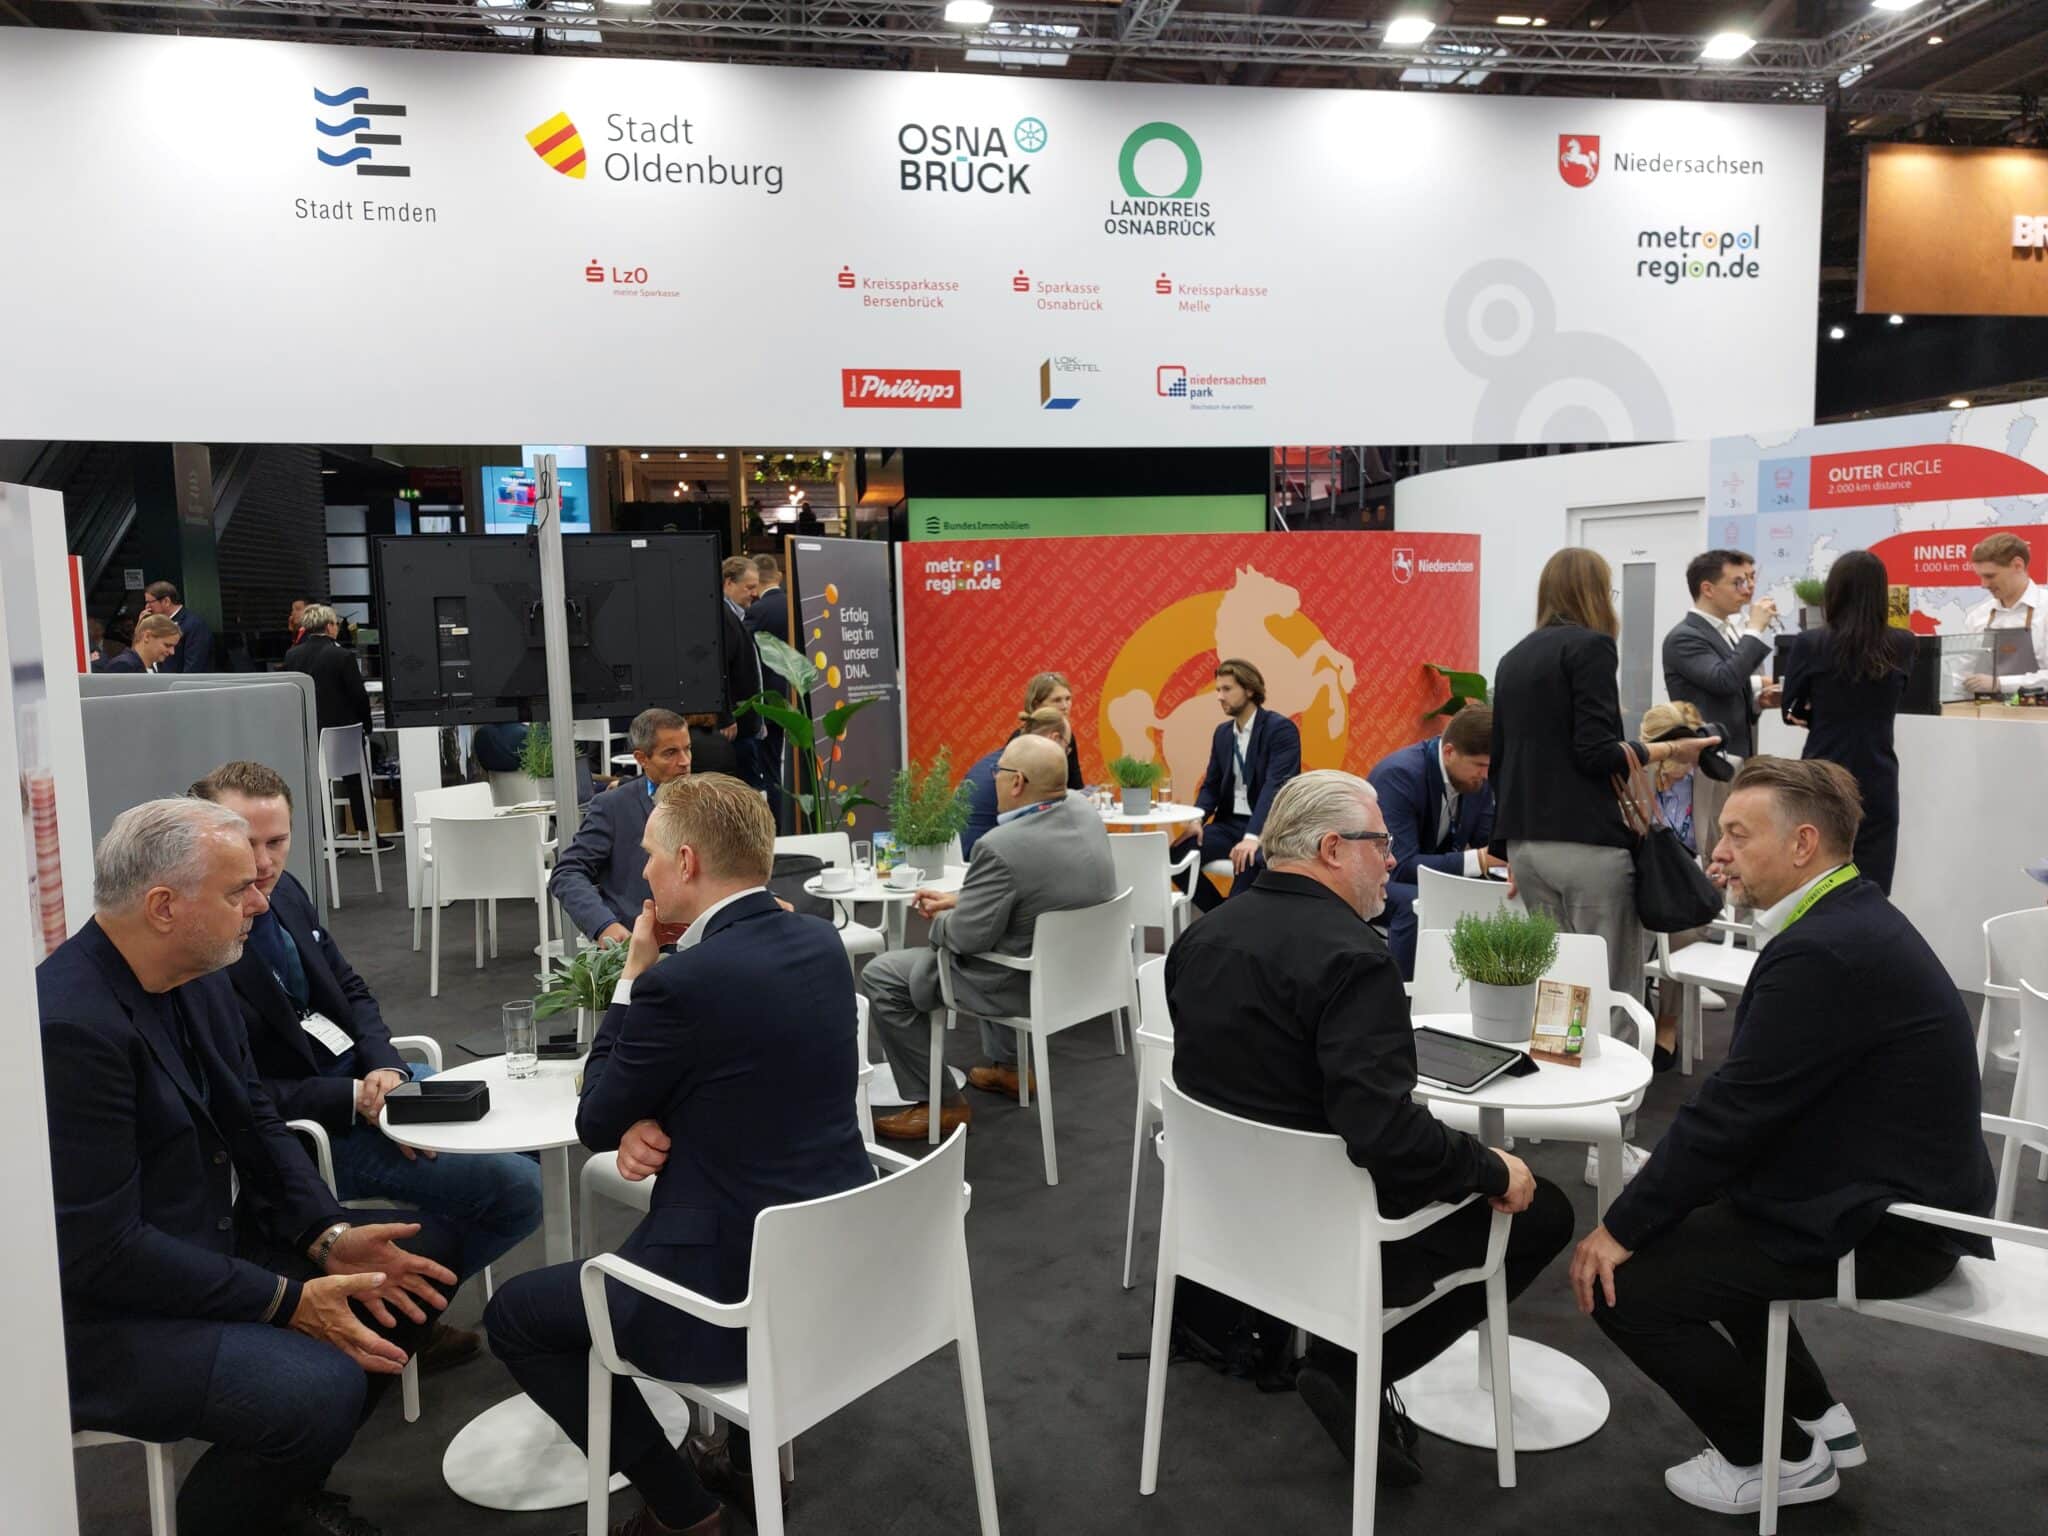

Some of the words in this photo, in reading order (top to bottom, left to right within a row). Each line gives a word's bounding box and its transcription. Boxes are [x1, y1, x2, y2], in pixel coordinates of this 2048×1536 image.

[607, 113, 693, 145] Stadt
[898, 123, 1008, 158] OSNA
[1614, 152, 1764, 175] Niedersachsen
[605, 152, 784, 195] Oldenburg
[901, 156, 1031, 194] BRÜCK
[295, 198, 353, 221] Stadt
[363, 201, 437, 223] Emden
[1110, 200, 1211, 217] LANDKREIS
[1104, 218, 1216, 237] OSNABRÜCK
[1638, 226, 1760, 256] metropol
[613, 267, 648, 283] LzO
[1637, 253, 1760, 284] region.de
[863, 277, 959, 292] Kreissparkasse
[1037, 281, 1100, 295] Sparkasse
[1178, 284, 1268, 297] Kreissparkasse
[863, 295, 944, 308] Bersenbrück
[1037, 298, 1103, 311] Osnabrück
[1178, 301, 1211, 312] Melle
[1190, 374, 1266, 385] niedersachsen
[860, 375, 955, 402] Philipps
[1190, 387, 1213, 400] park
[1828, 464, 1883, 482] OUTER
[1887, 459, 1942, 477] CIRCLE
[1828, 483, 1854, 494] 2.000
[1856, 483, 1870, 492] km
[1873, 480, 1912, 490] distance
[1914, 544, 1967, 560] INNER
[925, 555, 1000, 576] metropol
[1418, 559, 1474, 572] Niedersachsen
[1914, 563, 1942, 572] 1.000
[1943, 562, 1960, 571] km
[925, 573, 1002, 595] region.de
[840, 608, 869, 626] Erfolg
[841, 626, 863, 645] liegt
[865, 627, 874, 640] in
[843, 648, 879, 660] unserer
[845, 664, 871, 679] DNA.
